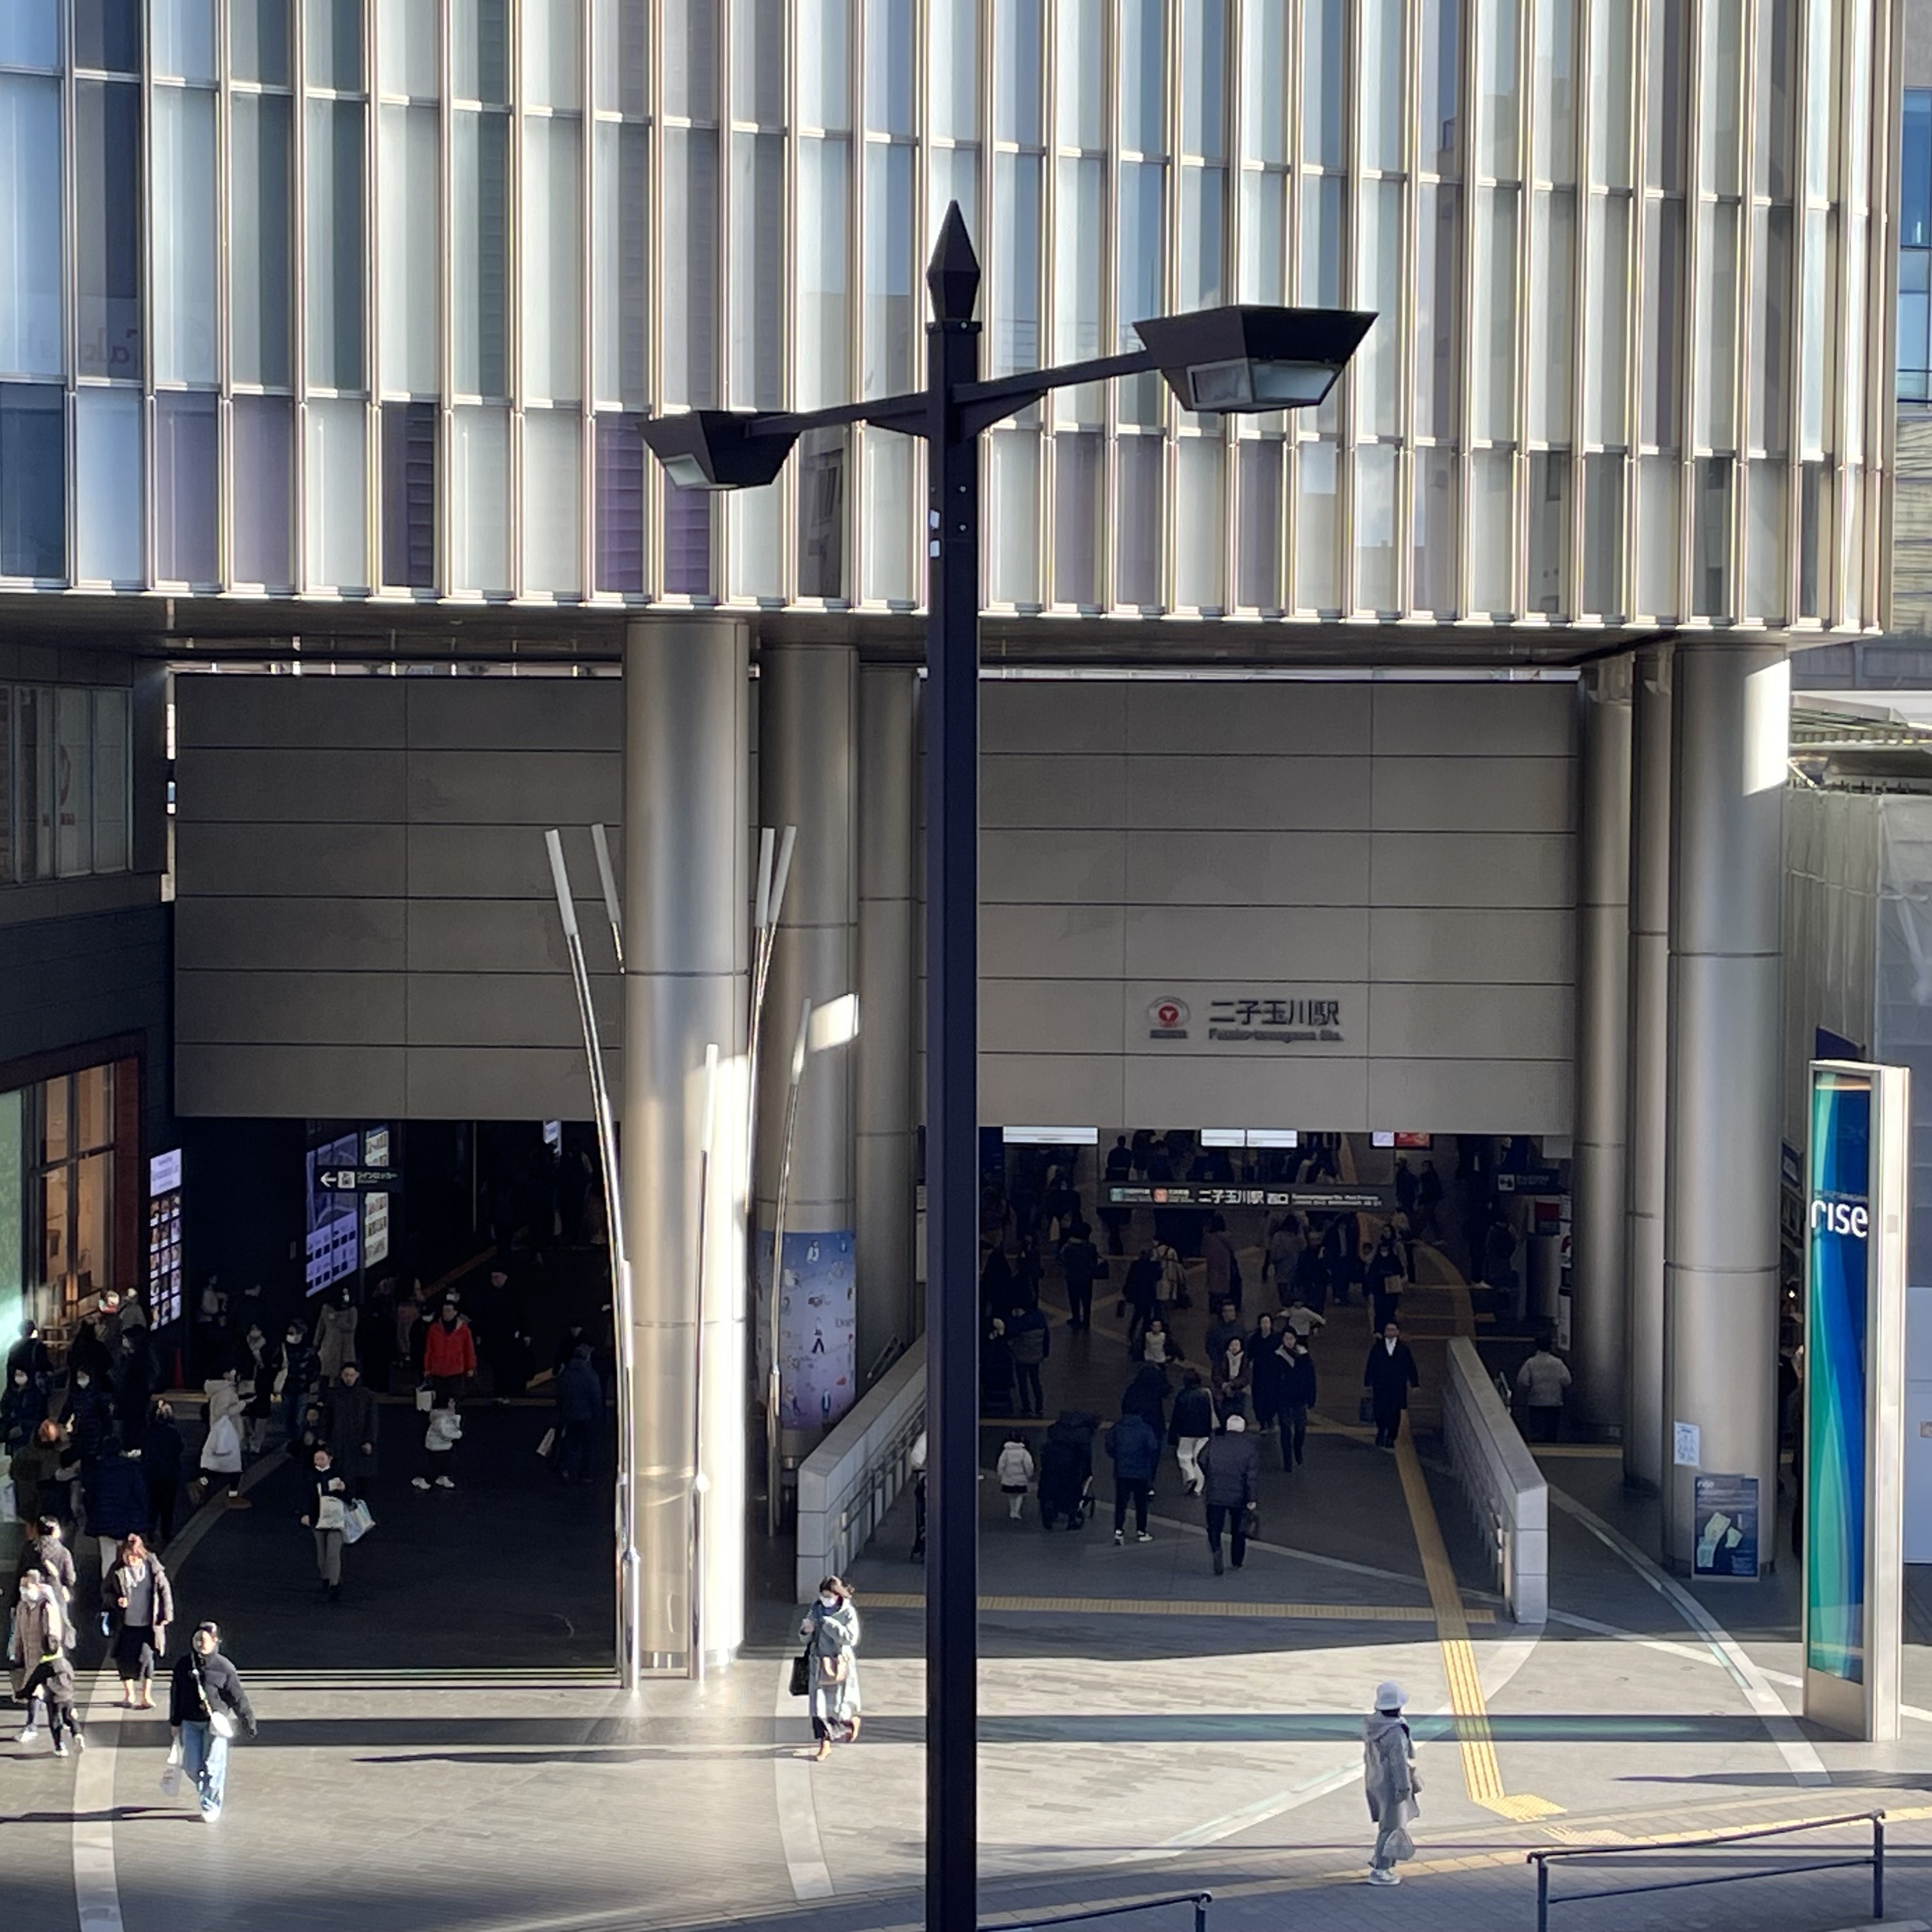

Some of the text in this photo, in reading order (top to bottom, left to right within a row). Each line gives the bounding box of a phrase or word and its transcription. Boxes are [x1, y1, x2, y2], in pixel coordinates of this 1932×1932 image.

[1209, 1000, 1339, 1025] 二子玉川駅
[1198, 1190, 1265, 1204] 二子玉川駅
[1811, 1199, 1868, 1238] rise
